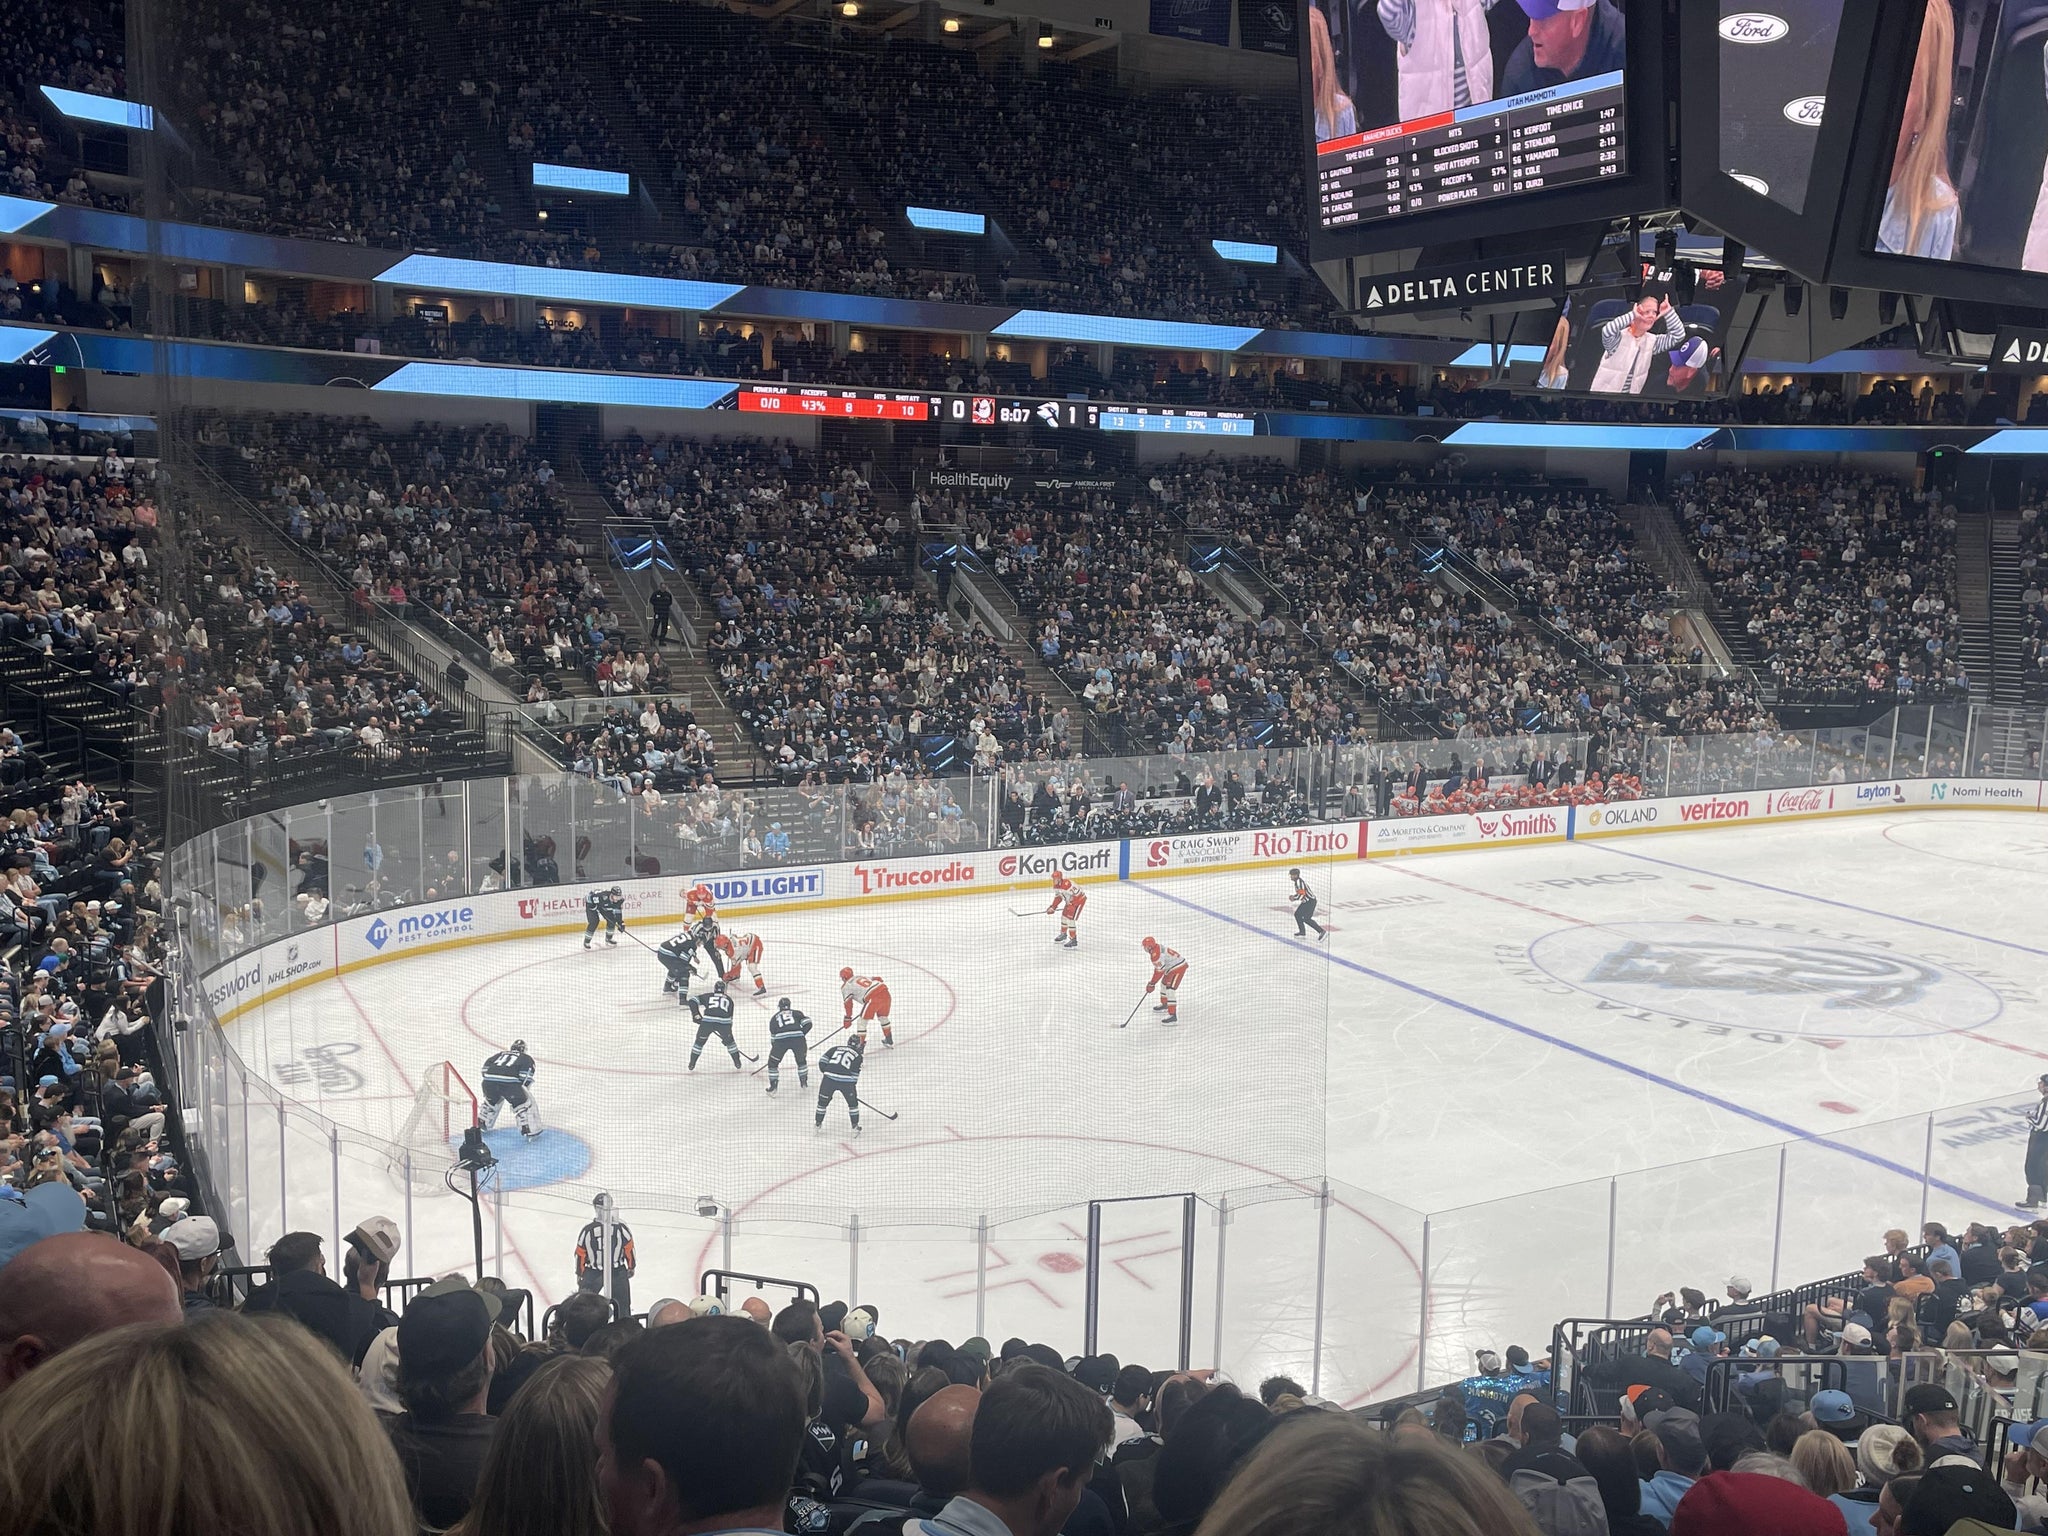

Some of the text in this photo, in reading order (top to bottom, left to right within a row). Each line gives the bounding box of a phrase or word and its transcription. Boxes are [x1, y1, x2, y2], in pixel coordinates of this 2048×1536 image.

[1730, 18, 1774, 38] Ford
[1508, 89, 1556, 107] UTAH MAMMOTH
[1546, 99, 1584, 116] TIME ON ICE
[1495, 118, 1500, 127] 5
[1512, 108, 1615, 138] 15 KERFOOT 1:47
[1363, 126, 1403, 142] ANAHEIM DUCKS
[1412, 128, 1462, 146] 7 HITS
[1495, 135, 1500, 144] 2
[1524, 135, 1556, 149] STENLUND
[1599, 122, 1615, 133] 2:01
[1345, 151, 1357, 161] TIME
[1364, 148, 1374, 157] ICE
[1434, 144, 1459, 157] BLOCKED
[1460, 140, 1478, 151] SHOTS
[1495, 151, 1503, 160] 13
[1513, 136, 1616, 165] 56 YAMAMOTO 2:19
[1412, 156, 1480, 177] 10 SHOT ATTEMPTS
[1491, 166, 1507, 176] 57%
[1525, 165, 1541, 175] COLE
[1600, 150, 1616, 161] 2:32
[1600, 164, 1616, 175] 2:43
[1409, 183, 1423, 192] 43%
[1441, 174, 1466, 186] FACEOFF
[1493, 182, 1505, 192] 0/1
[1411, 188, 1477, 207] 0/0 POWER PLAYS
[1332, 202, 1352, 212] CARLSON
[1388, 263, 1553, 304] DELTA CENTER
[773, 387, 787, 395] PLAY
[801, 389, 828, 397] FACEOFFS
[895, 394, 909, 402] SHOT
[760, 397, 965, 418] 0/0 43% 8 7 10 1 0
[1000, 406, 1076, 424] 8:07 1
[1089, 414, 1096, 424] 9
[1113, 416, 1237, 432] 13 5 2 57% 0/1
[930, 472, 1012, 490] HealthEquity
[1857, 784, 1891, 801] Layton
[1952, 786, 2023, 798] Nomi Health
[1605, 806, 1657, 825] OKLAND
[1680, 797, 1749, 821] verizon
[1392, 828, 1426, 836] MORETON
[1433, 824, 1466, 833] COMPANY
[1501, 813, 1556, 837] Smith's
[1172, 836, 1240, 850] CRAIG SWAPP
[1186, 847, 1233, 857] ASSOCIATES
[1253, 830, 1348, 857] Rio Tinto
[1018, 849, 1111, 875] Ken Garff
[873, 861, 975, 889] Trucordia
[1543, 871, 1664, 889] PACS
[640, 890, 662, 898] CARE
[704, 874, 818, 899] UD LIGHT
[398, 907, 474, 934] moxie
[399, 925, 474, 943] PEST CONTROL
[268, 960, 321, 985] NHLSHOP.COM
[708, 996, 730, 1012] 50
[829, 1051, 855, 1070] 56
